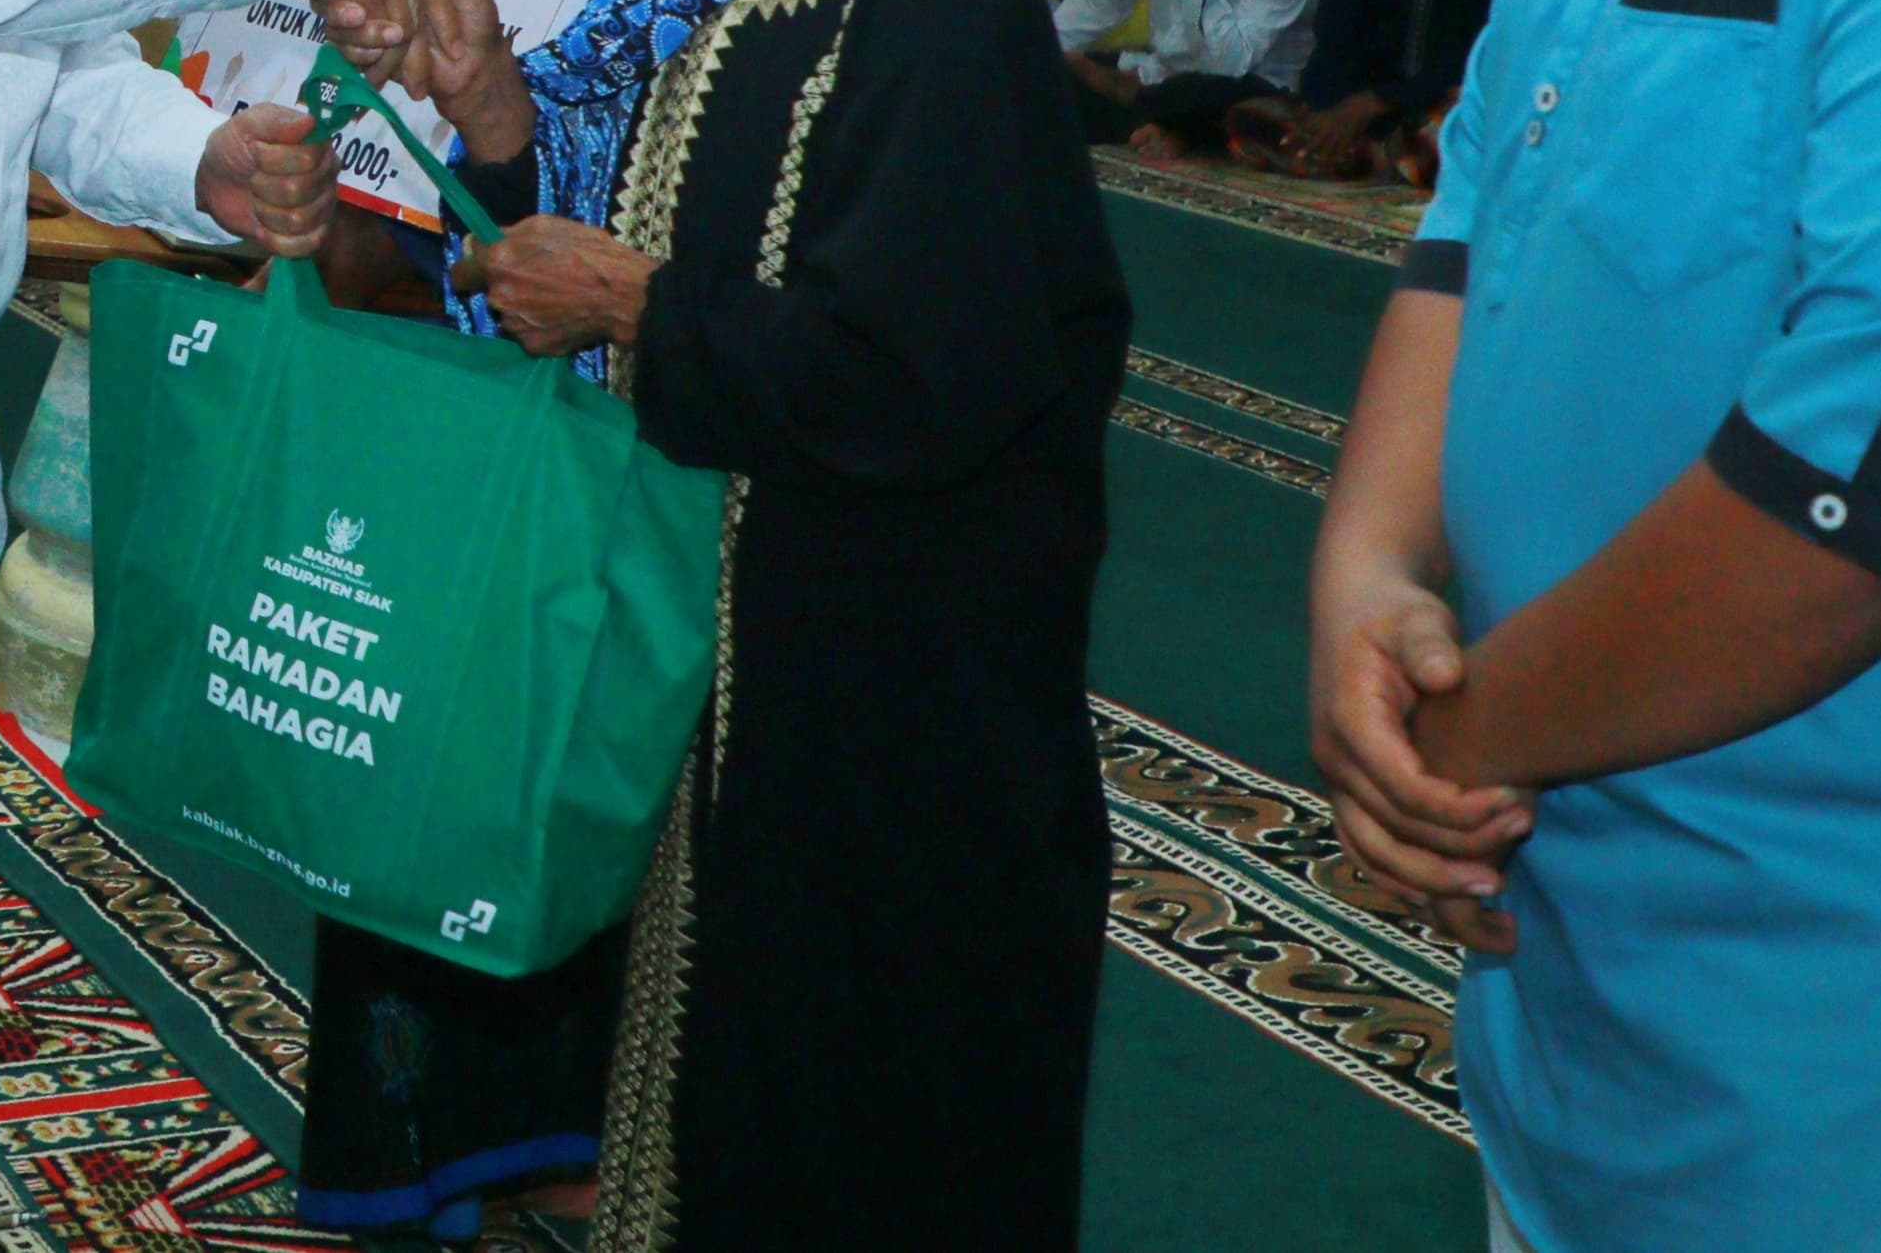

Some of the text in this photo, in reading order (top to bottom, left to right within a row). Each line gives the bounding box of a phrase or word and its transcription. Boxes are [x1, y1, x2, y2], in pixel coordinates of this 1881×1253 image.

[263, 554, 353, 600] KABUPATEN
[353, 588, 394, 614] SIAK
[301, 544, 366, 578] BAZNAS
[249, 591, 380, 662] PAKET
[207, 623, 403, 723] RAMADAN
[206, 671, 375, 767] BAHAGIA
